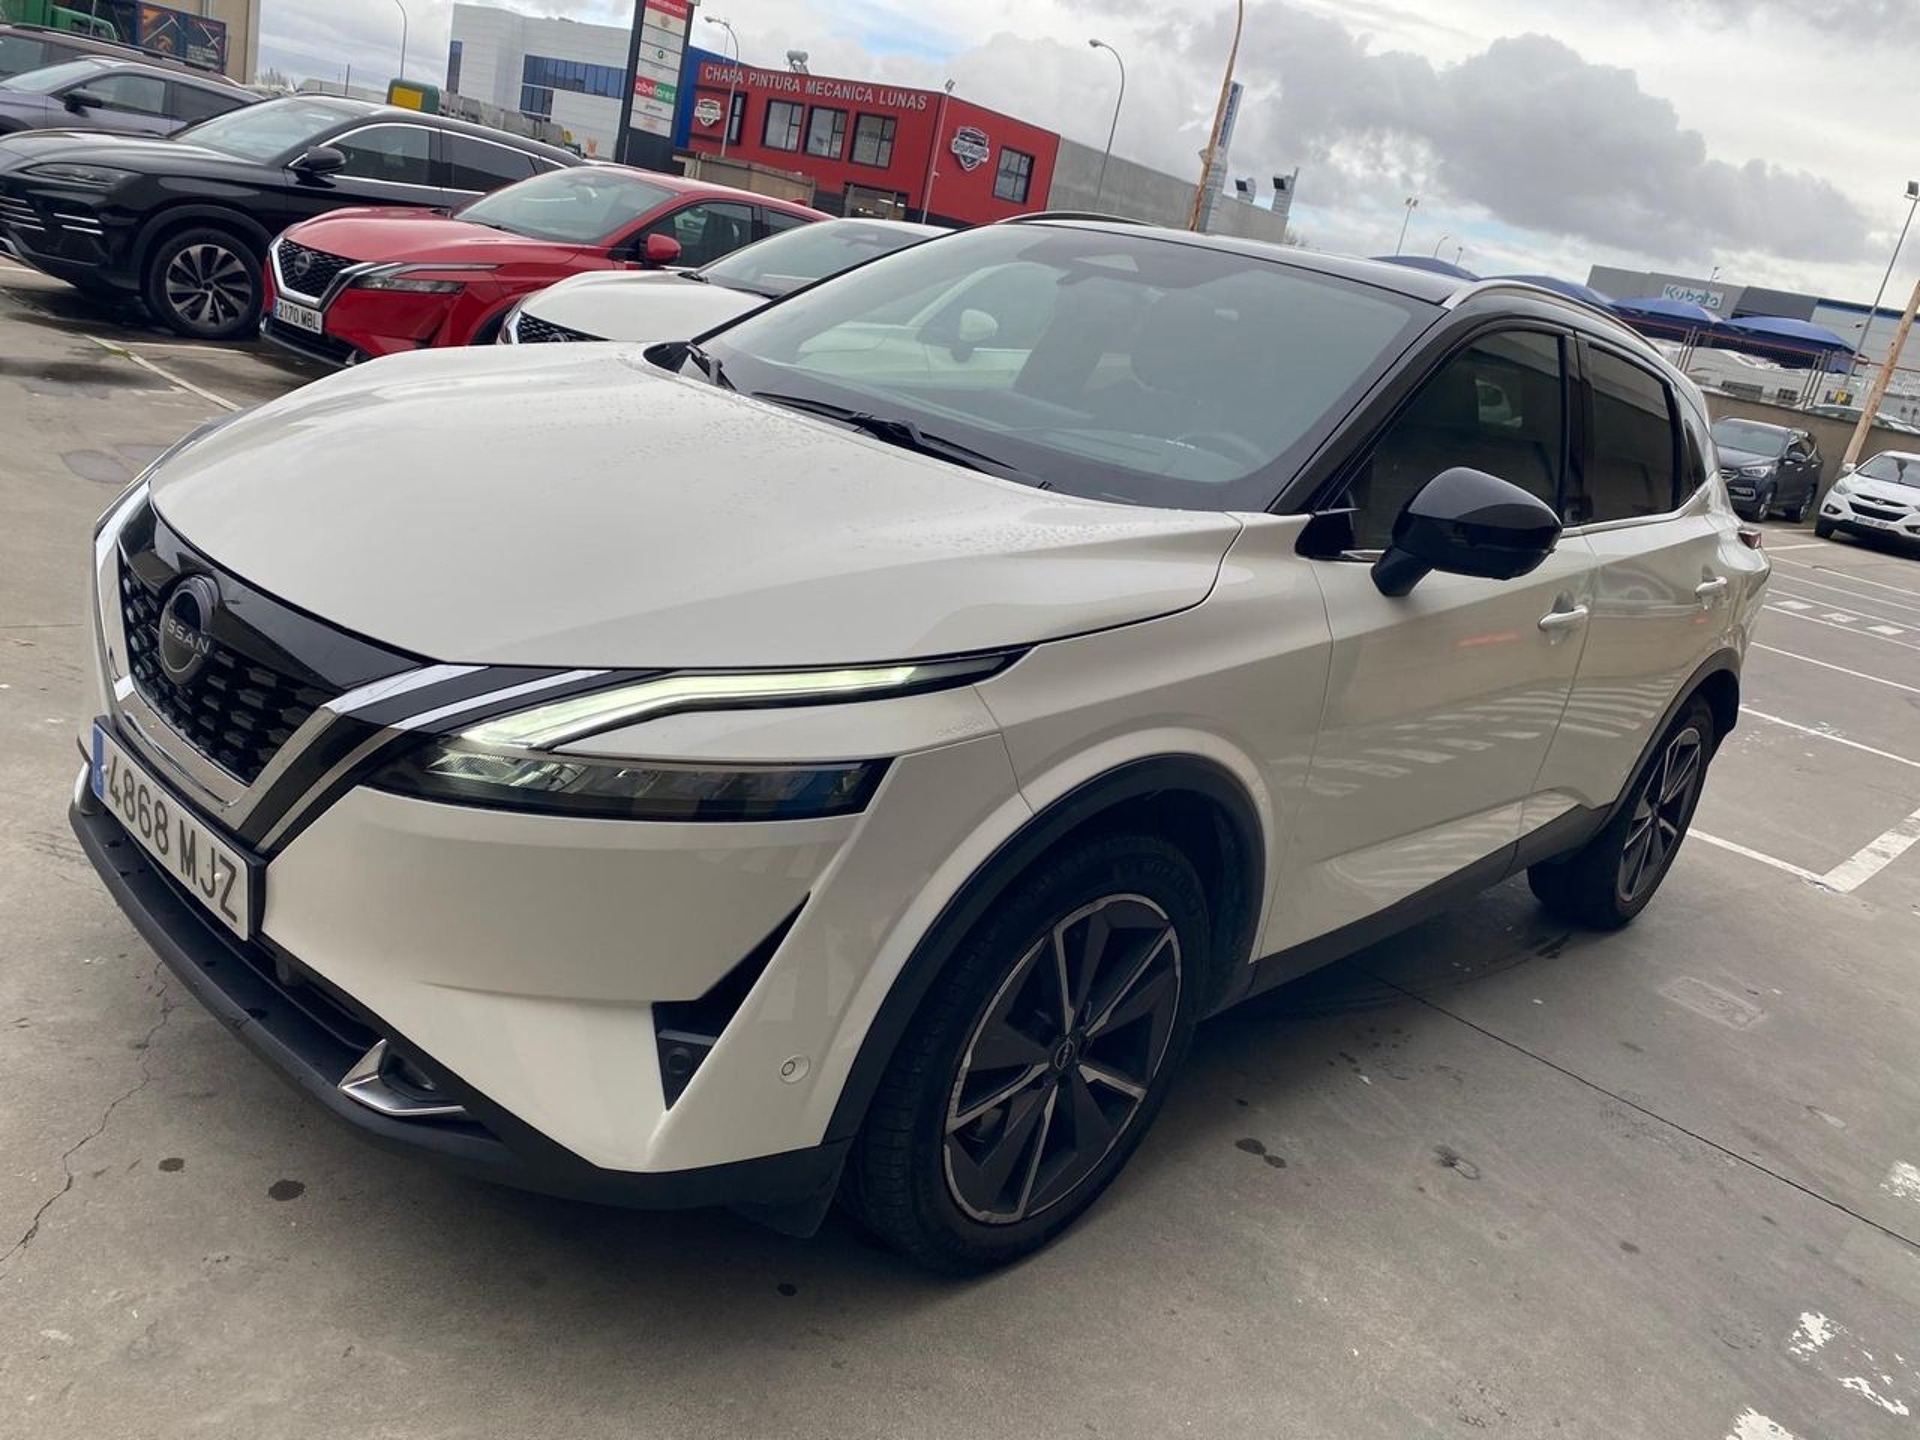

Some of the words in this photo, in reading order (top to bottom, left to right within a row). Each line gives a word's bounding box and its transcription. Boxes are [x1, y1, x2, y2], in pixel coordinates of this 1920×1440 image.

[705, 66, 744, 84] CHAPA
[748, 72, 801, 93] PINTURA
[805, 80, 874, 104] MECANICA
[878, 89, 928, 110] LUNAS
[1664, 285, 1719, 307] Kubota
[278, 301, 300, 324] 2170
[301, 311, 320, 331] MBL
[167, 617, 211, 654] SSAN
[109, 754, 170, 858] 4868
[179, 818, 238, 924] MJZ
